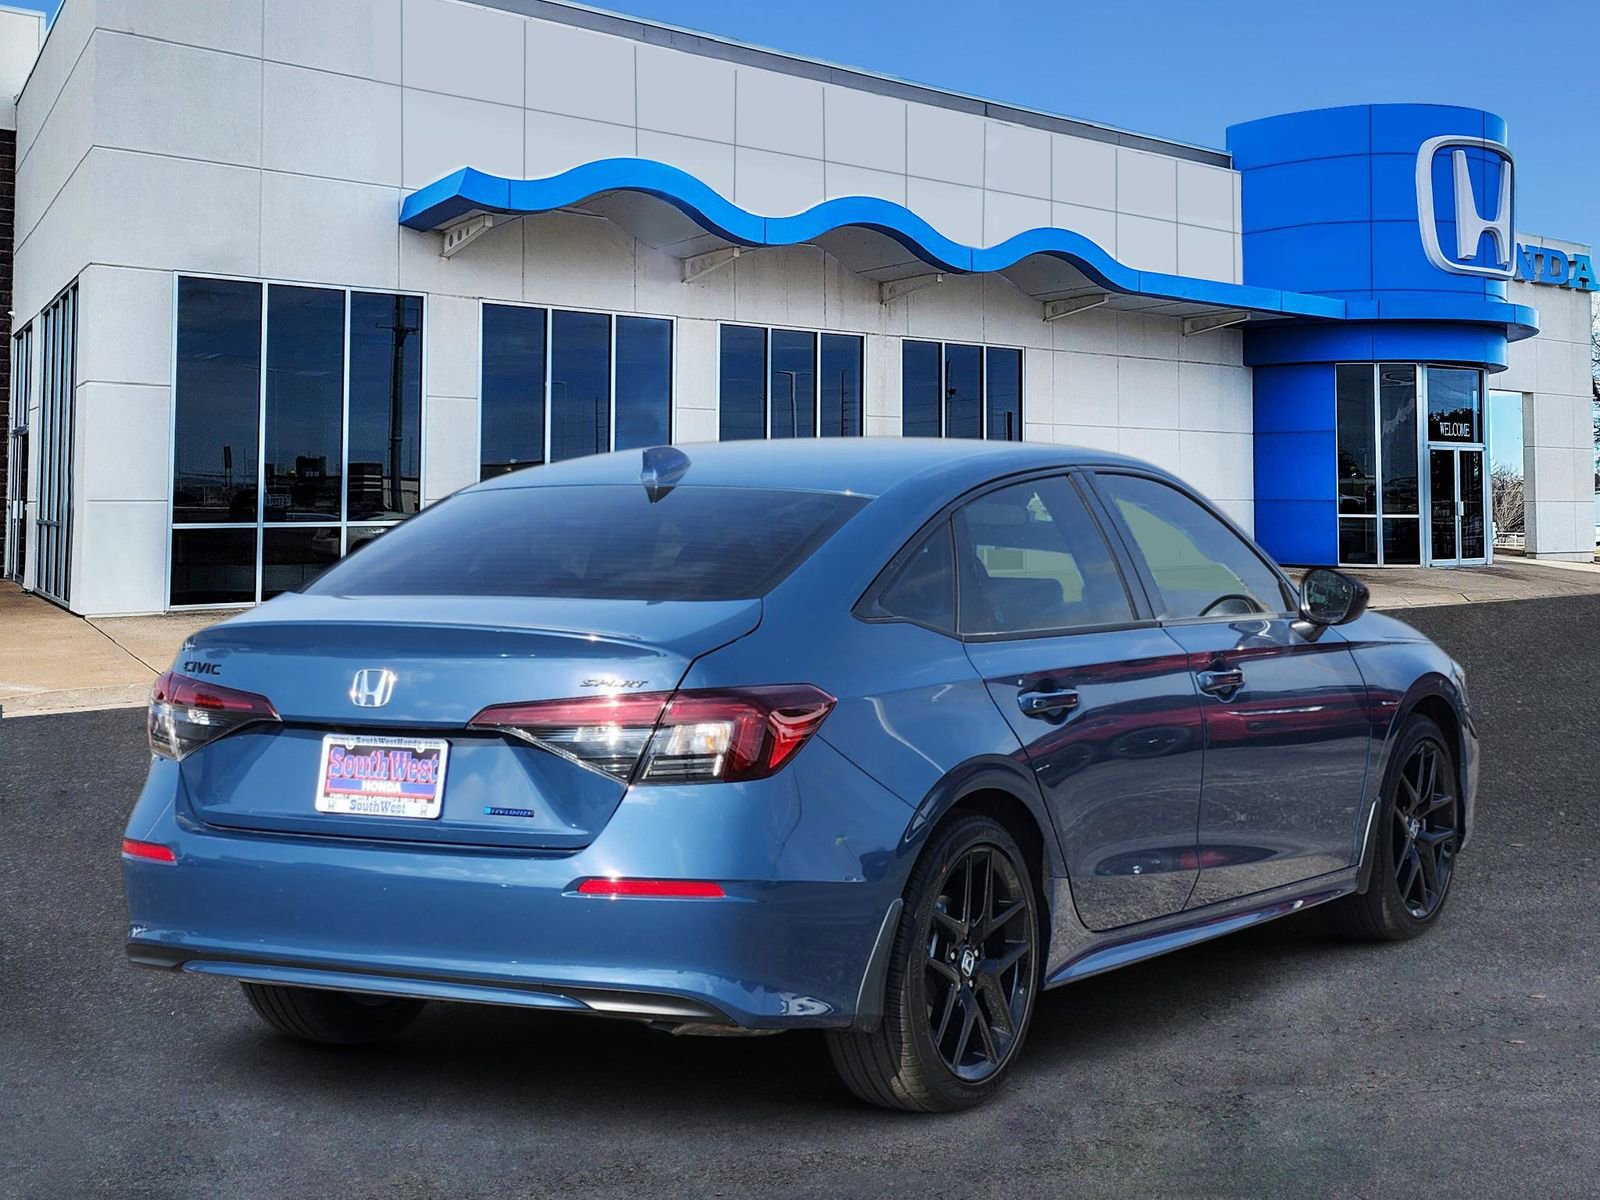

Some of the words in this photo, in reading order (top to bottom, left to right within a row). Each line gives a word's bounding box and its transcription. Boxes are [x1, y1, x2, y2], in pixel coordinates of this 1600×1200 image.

[1440, 422, 1470, 437] WELCOME
[184, 661, 222, 675] CIVIC
[361, 780, 402, 793] HONDA
[350, 800, 406, 815] SouthWest
